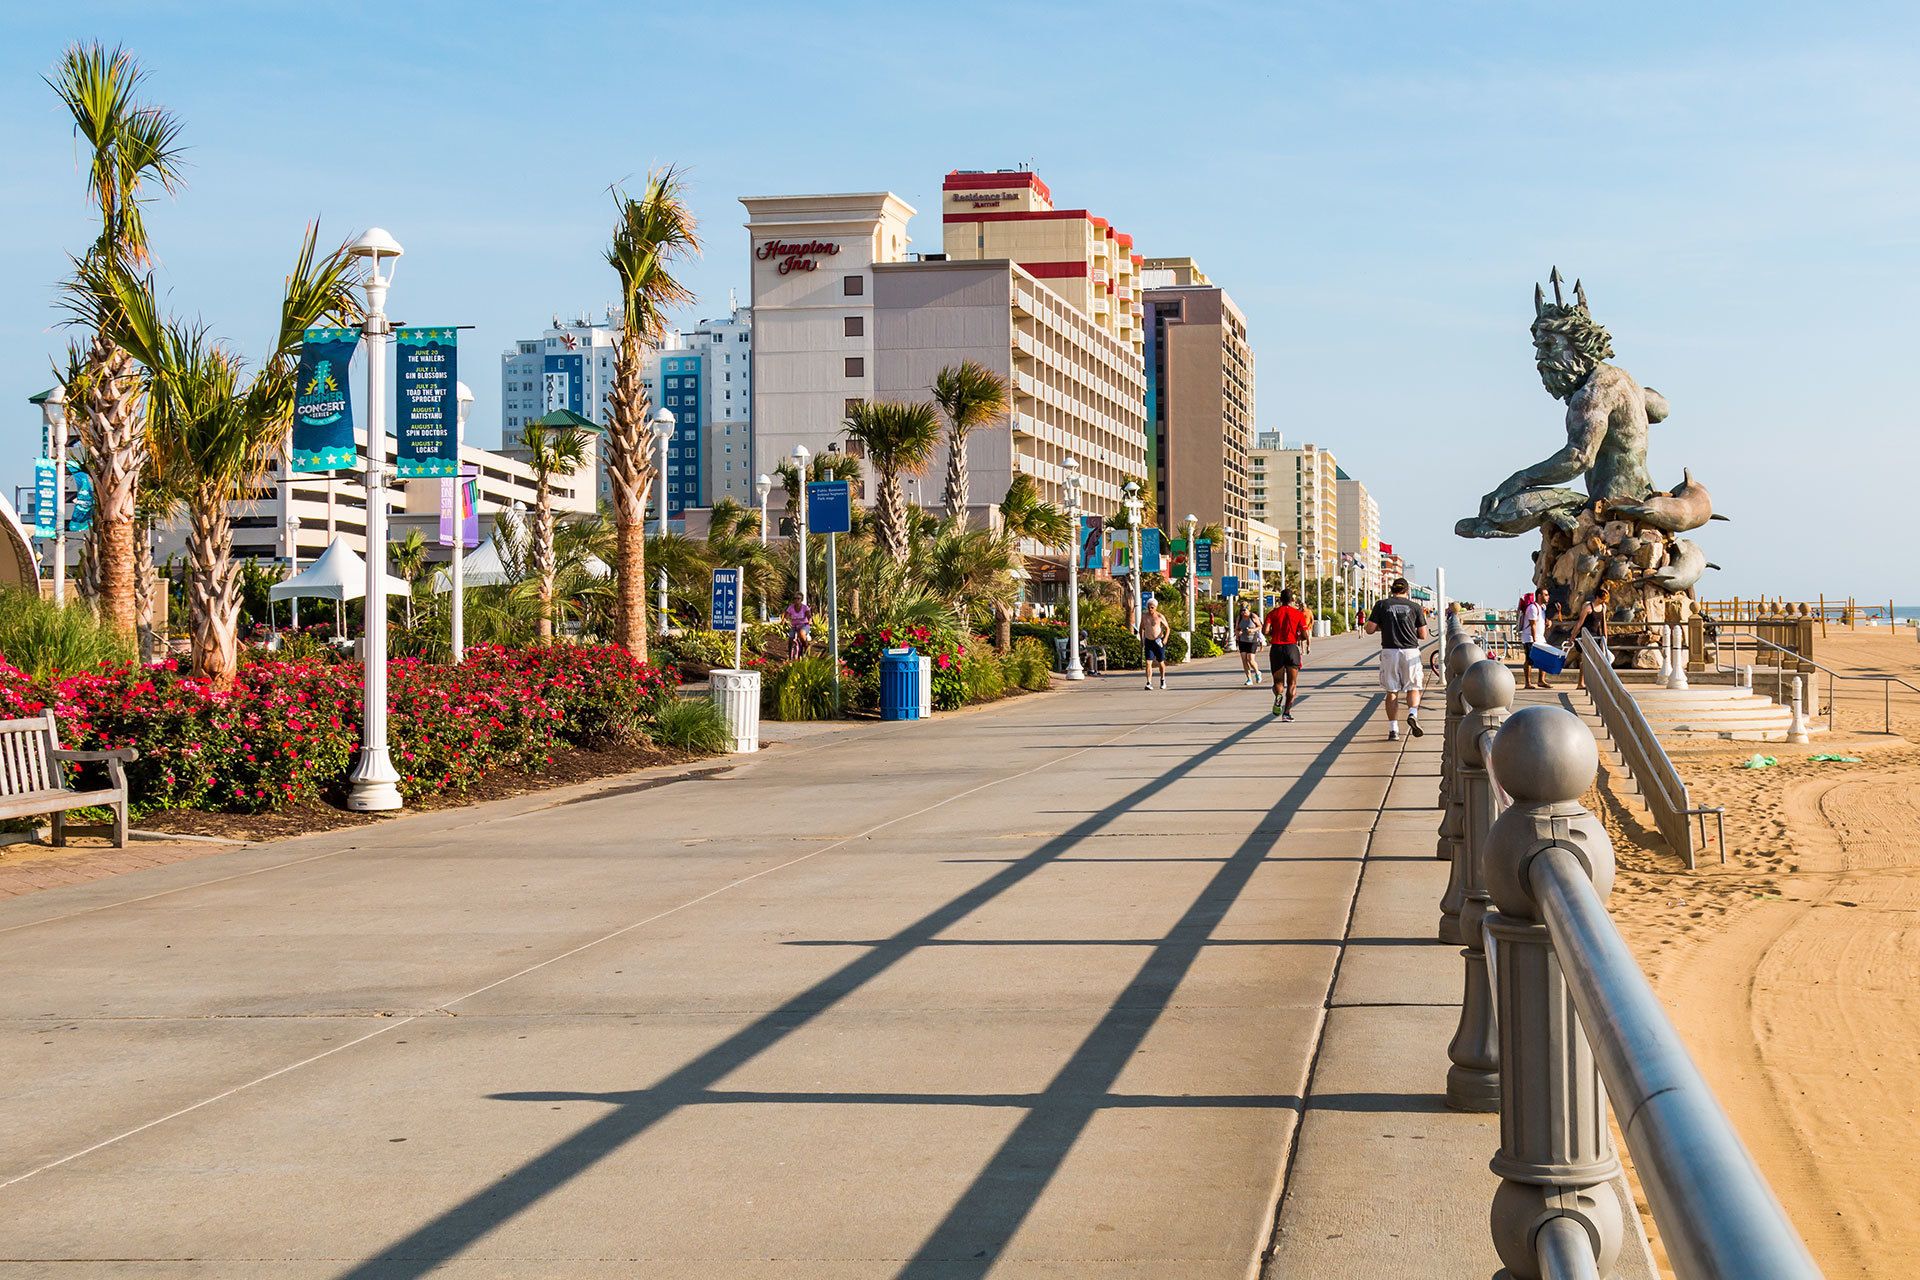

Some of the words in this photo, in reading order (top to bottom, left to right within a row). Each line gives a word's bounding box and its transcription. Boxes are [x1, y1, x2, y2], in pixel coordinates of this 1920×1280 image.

[952, 193, 1001, 202] Residence
[1001, 192, 1019, 200] Inn
[756, 240, 840, 260] Hampton
[778, 255, 818, 275] Inn
[298, 391, 344, 405] SUMMER
[297, 401, 346, 415] CONCERT
[410, 412, 443, 420] MATISYAHU
[405, 429, 420, 437] SPIN
[421, 429, 448, 437] DOCTORS
[415, 446, 439, 454] LOCASH
[715, 574, 736, 583] ONLY
